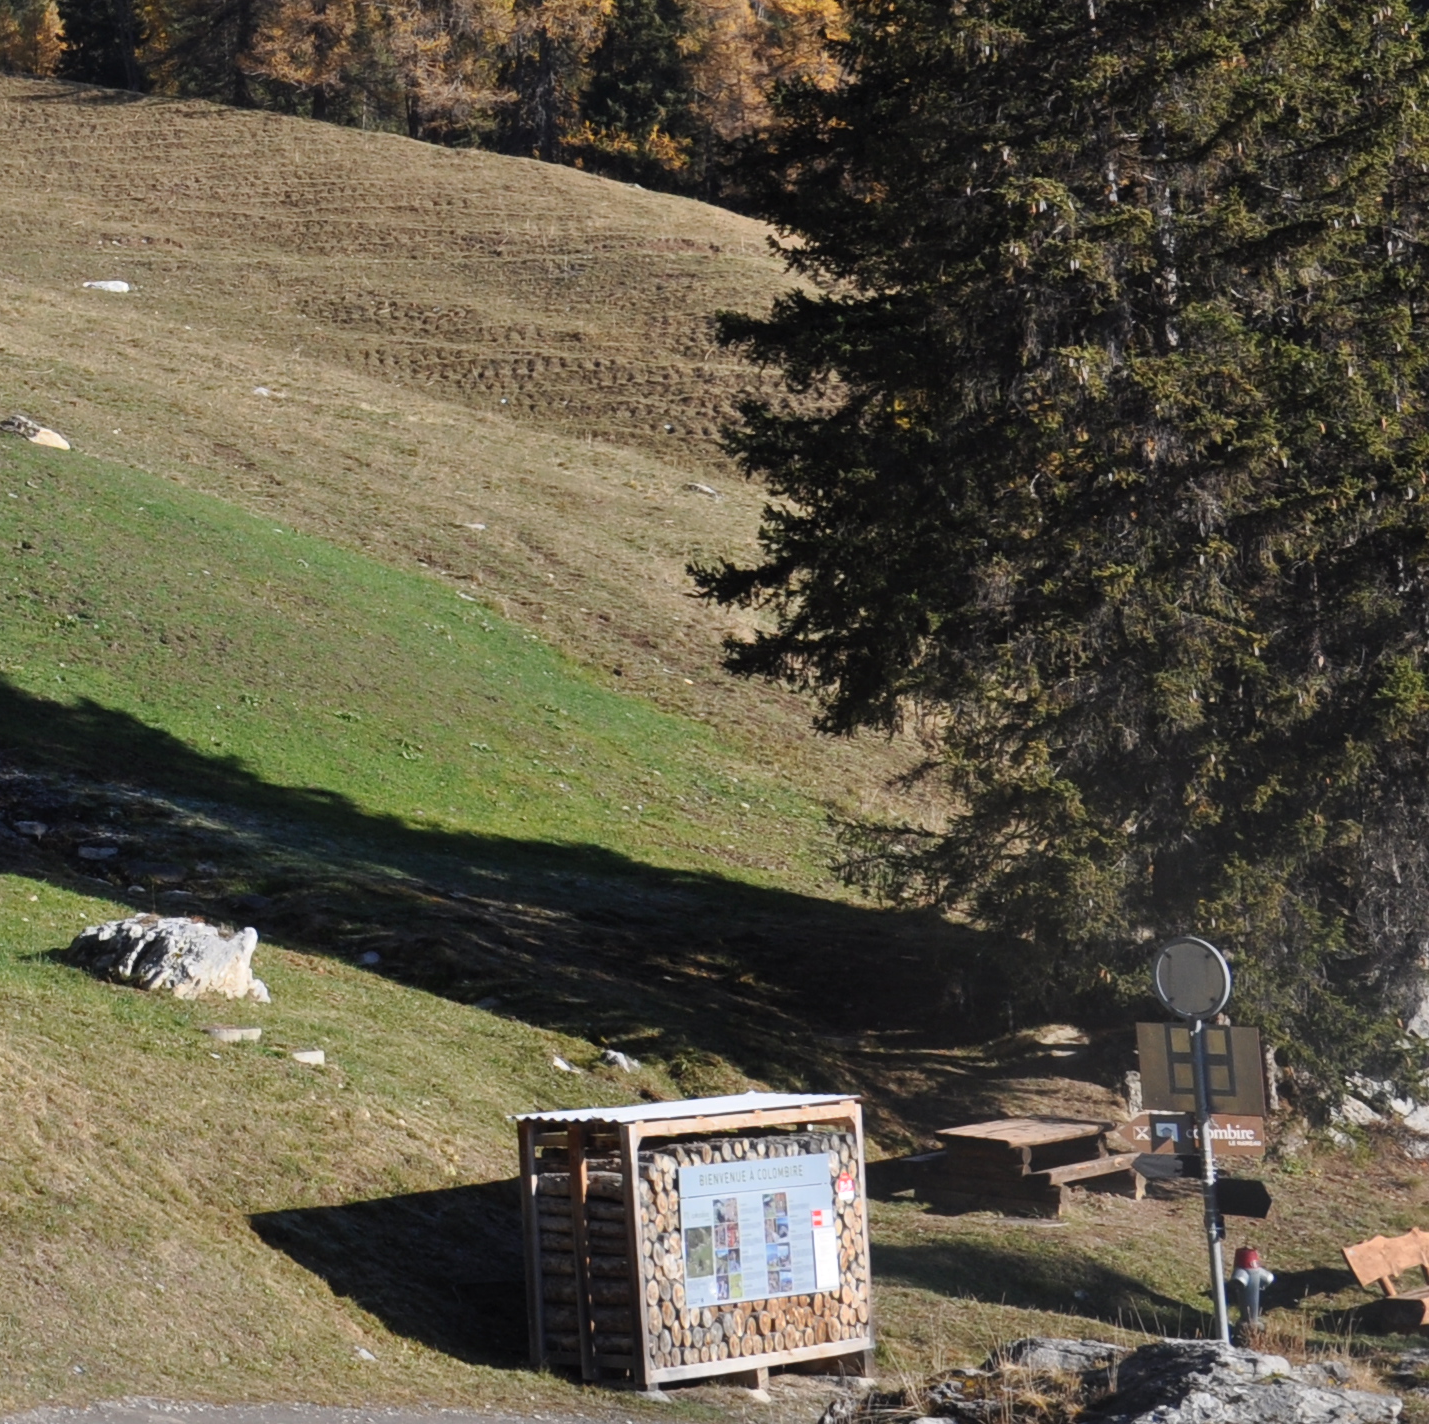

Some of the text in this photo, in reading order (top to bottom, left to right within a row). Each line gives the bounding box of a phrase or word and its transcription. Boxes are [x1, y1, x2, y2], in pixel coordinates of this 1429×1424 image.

[699, 1165, 804, 1186] BIENVENUE À COLOMBIRE
